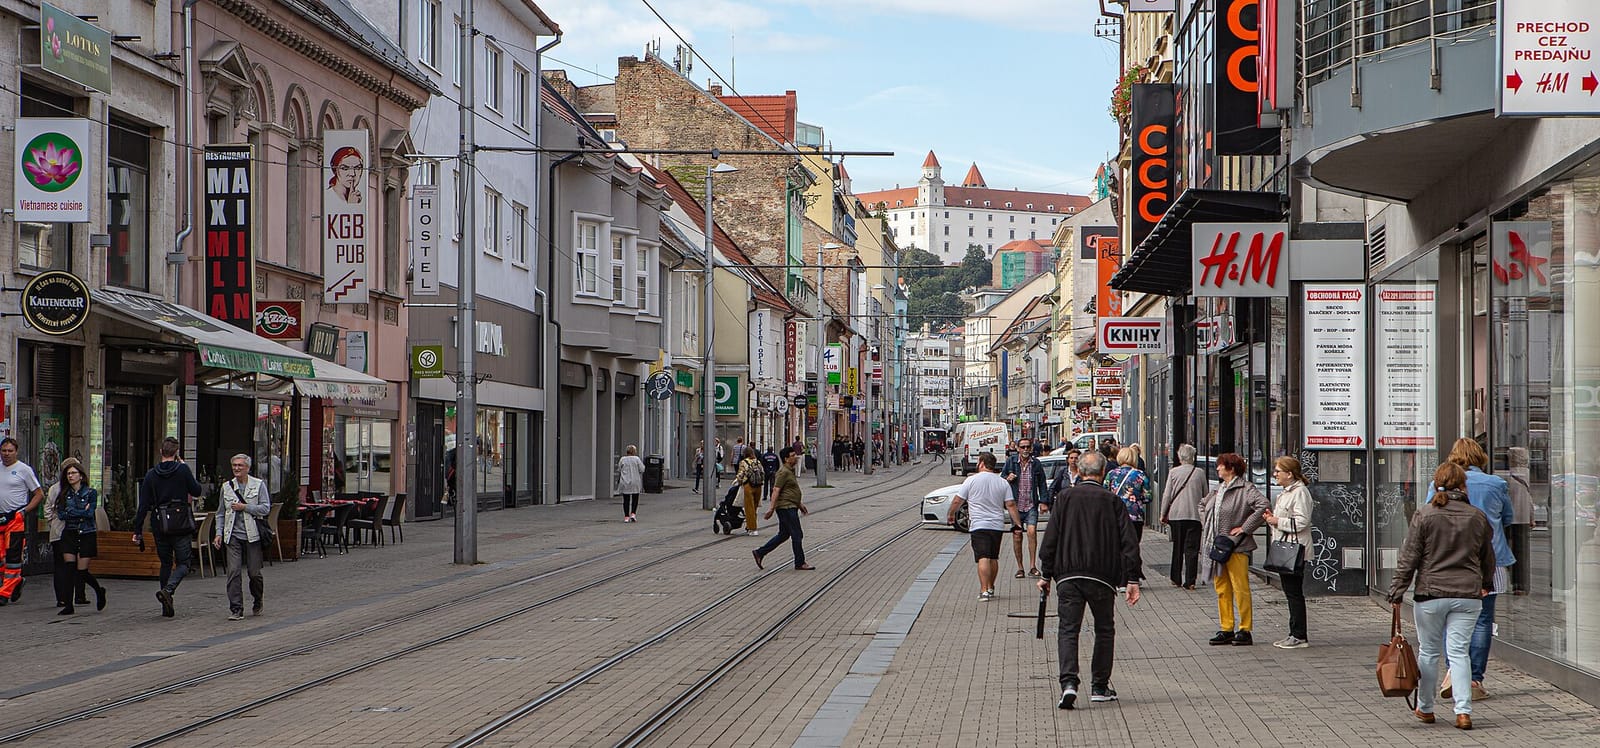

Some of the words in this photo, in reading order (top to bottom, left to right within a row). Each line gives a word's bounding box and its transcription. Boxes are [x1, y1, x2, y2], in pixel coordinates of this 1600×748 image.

[1516, 22, 1590, 33] PRECHOD
[65, 30, 101, 57] LOTUS
[1538, 36, 1568, 47] CEZ
[1515, 46, 1591, 63] PREDAJŇU
[1536, 72, 1569, 94] H&M
[205, 152, 250, 161] RESTAURANT
[1138, 124, 1168, 223] CCC
[19, 200, 58, 211] Vietnamese
[60, 200, 83, 211] cuisine
[327, 214, 364, 239] KGB
[420, 198, 431, 289] HOSTEL
[336, 244, 364, 264] PUB
[1199, 231, 1285, 288] H&M
[29, 295, 84, 308] KALTENECKER
[1110, 328, 1161, 342] KNIHY
[787, 323, 795, 382] Apartment
